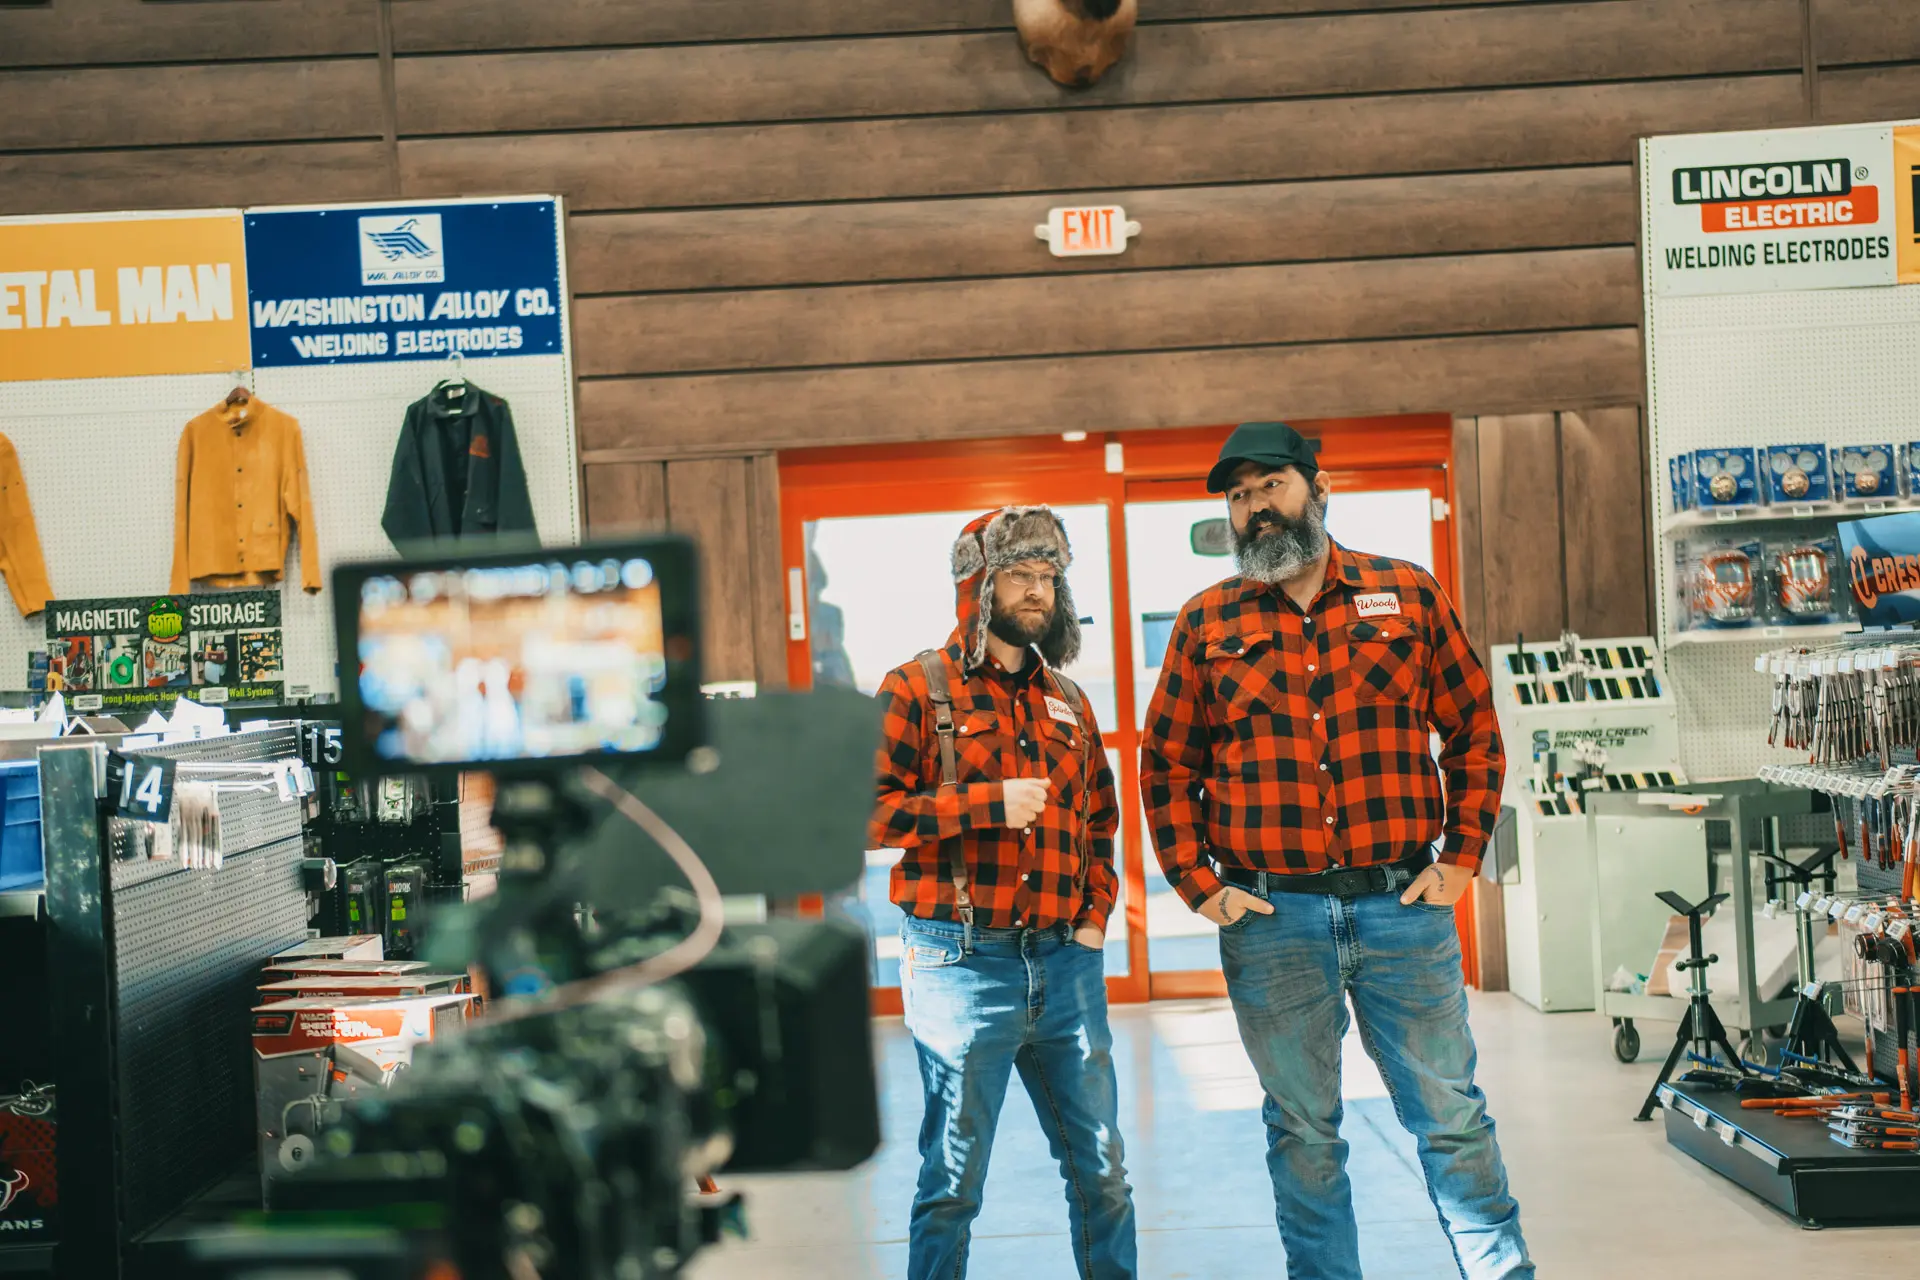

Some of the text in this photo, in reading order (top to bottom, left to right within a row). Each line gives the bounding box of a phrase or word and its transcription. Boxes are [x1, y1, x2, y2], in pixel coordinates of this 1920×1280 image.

[1680, 162, 1842, 200] LINCOLN
[1063, 209, 1115, 250] EXIT
[1725, 200, 1853, 229] ELECTRIC
[1665, 236, 1889, 270] WELDING ELECTRODES
[392, 270, 422, 280] ALLOY
[425, 270, 440, 279] CO.
[117, 263, 233, 325] MAN
[253, 288, 556, 328] WASHINGTON ALLOY CO.
[291, 326, 522, 358] WELDING ELECTRODES
[1871, 553, 1920, 592] CRES
[56, 608, 140, 632] MAGNETIC
[190, 602, 265, 626] STORAGE
[1357, 598, 1396, 610] Woody
[102, 695, 123, 706] trong
[125, 692, 159, 704] Magnetic
[229, 688, 244, 698] Wall
[247, 687, 274, 699] System
[305, 727, 342, 764] 15
[1555, 729, 1603, 739] SPRING
[1606, 727, 1649, 737] CREEK
[119, 761, 163, 813] 14
[306, 1029, 341, 1038] PANEL
